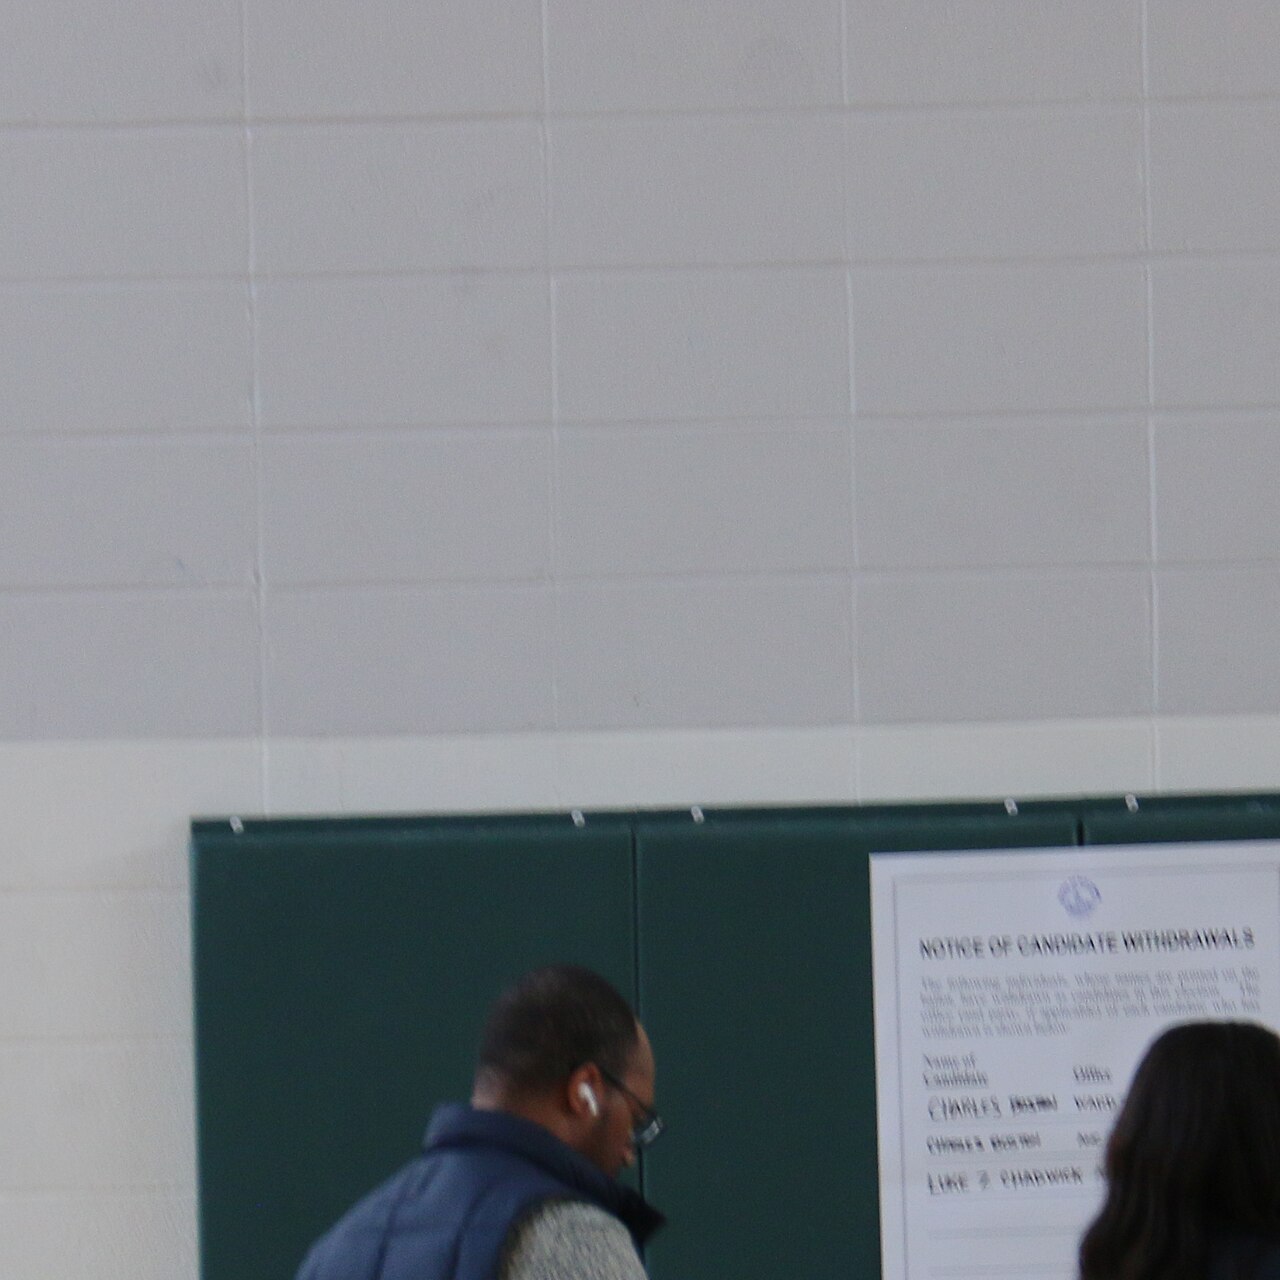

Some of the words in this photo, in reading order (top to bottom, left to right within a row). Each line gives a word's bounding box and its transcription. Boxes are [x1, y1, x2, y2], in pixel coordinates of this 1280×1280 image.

[919, 936, 987, 960] NOTICE
[988, 934, 1012, 958] OF
[1017, 931, 1119, 957] CANDIDATE
[1121, 927, 1256, 954] WITHDRAWALS
